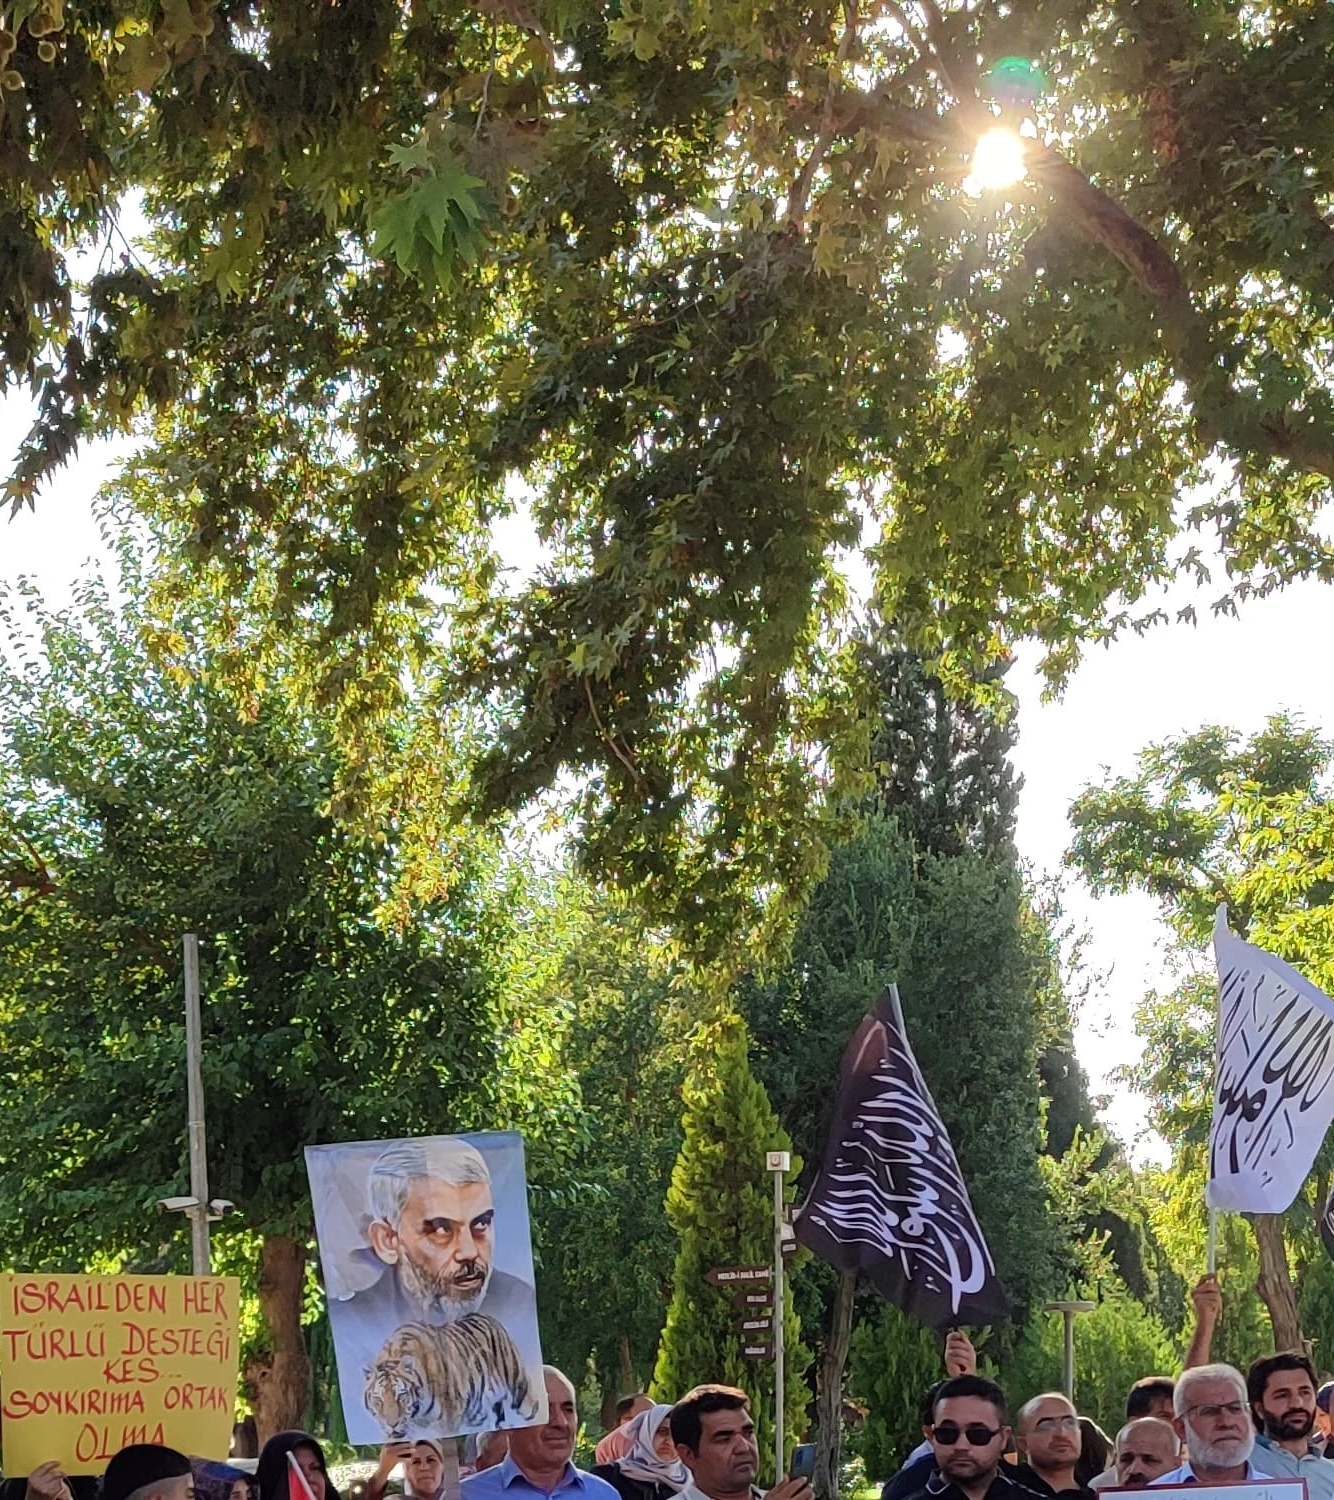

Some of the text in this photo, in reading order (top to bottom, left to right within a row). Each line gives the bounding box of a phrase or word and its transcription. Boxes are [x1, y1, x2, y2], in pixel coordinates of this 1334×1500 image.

[183, 1280, 229, 1320] HER
[2, 1321, 106, 1363] TÜRLÜ
[2, 1383, 229, 1420] SOYKIRIMA ORTAK
[75, 1421, 166, 1463] OLMA
